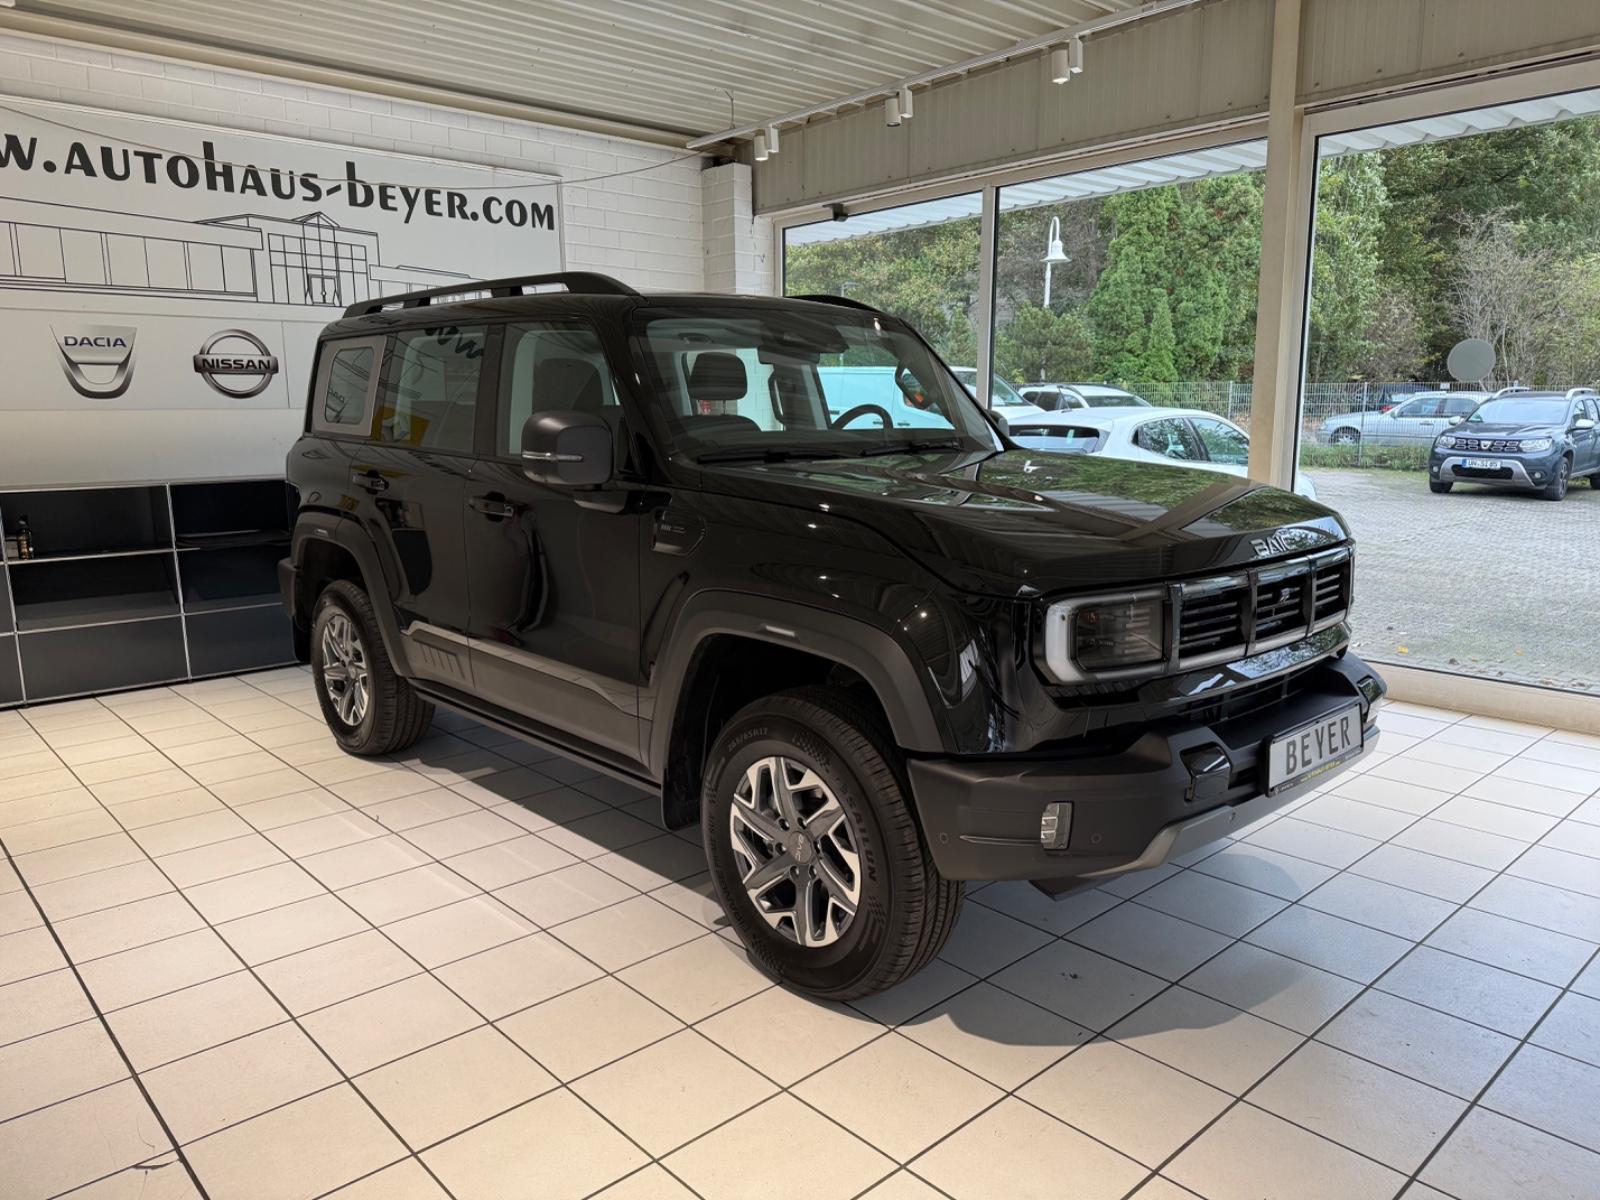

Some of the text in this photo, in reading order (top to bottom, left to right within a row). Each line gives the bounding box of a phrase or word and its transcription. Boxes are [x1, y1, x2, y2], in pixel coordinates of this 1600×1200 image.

[63, 335, 127, 348] DACIA
[202, 357, 271, 370] NISSAN
[1286, 716, 1351, 776] BEYER
